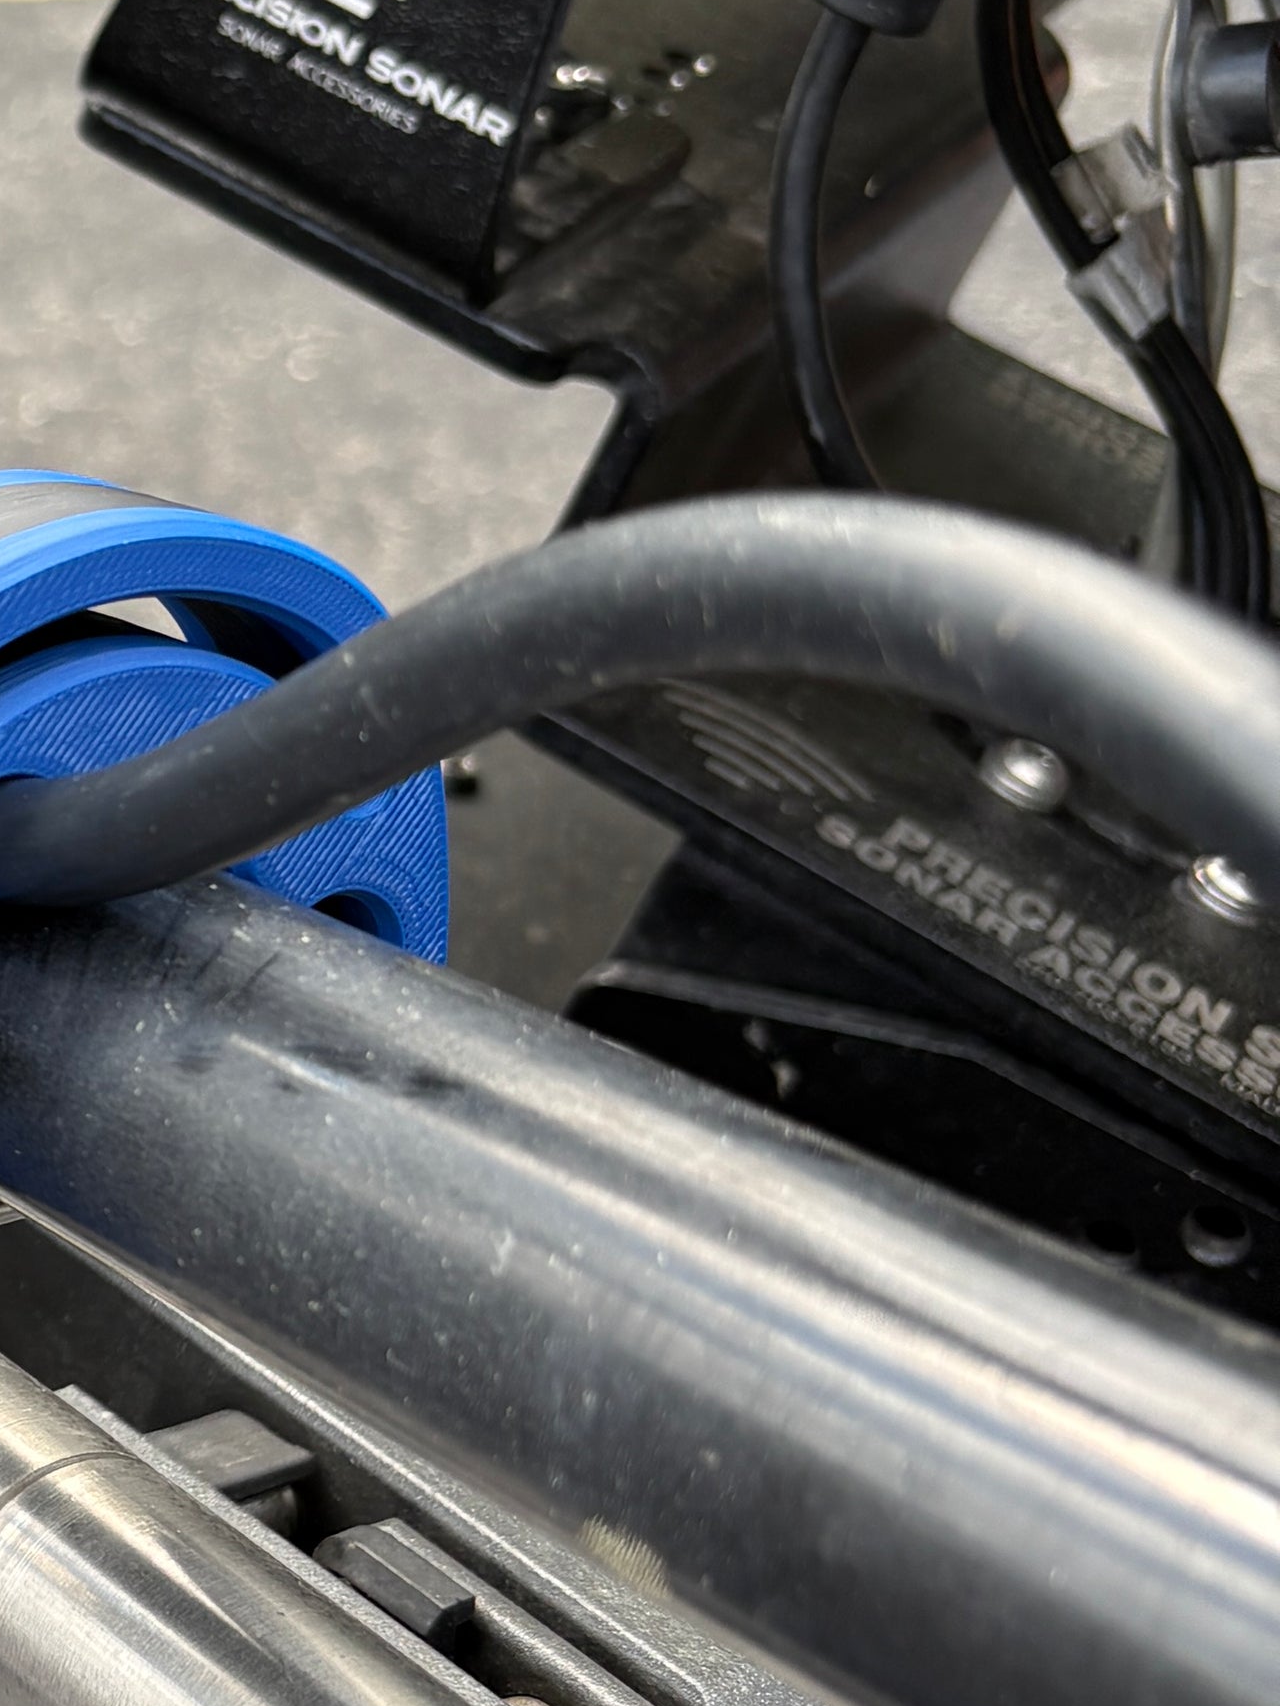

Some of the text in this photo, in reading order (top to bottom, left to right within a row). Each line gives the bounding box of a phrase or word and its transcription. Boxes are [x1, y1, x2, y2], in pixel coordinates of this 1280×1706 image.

[364, 45, 518, 148] SONAR
[814, 813, 1021, 948] SONAR
[880, 816, 1235, 1036] PRECISION
